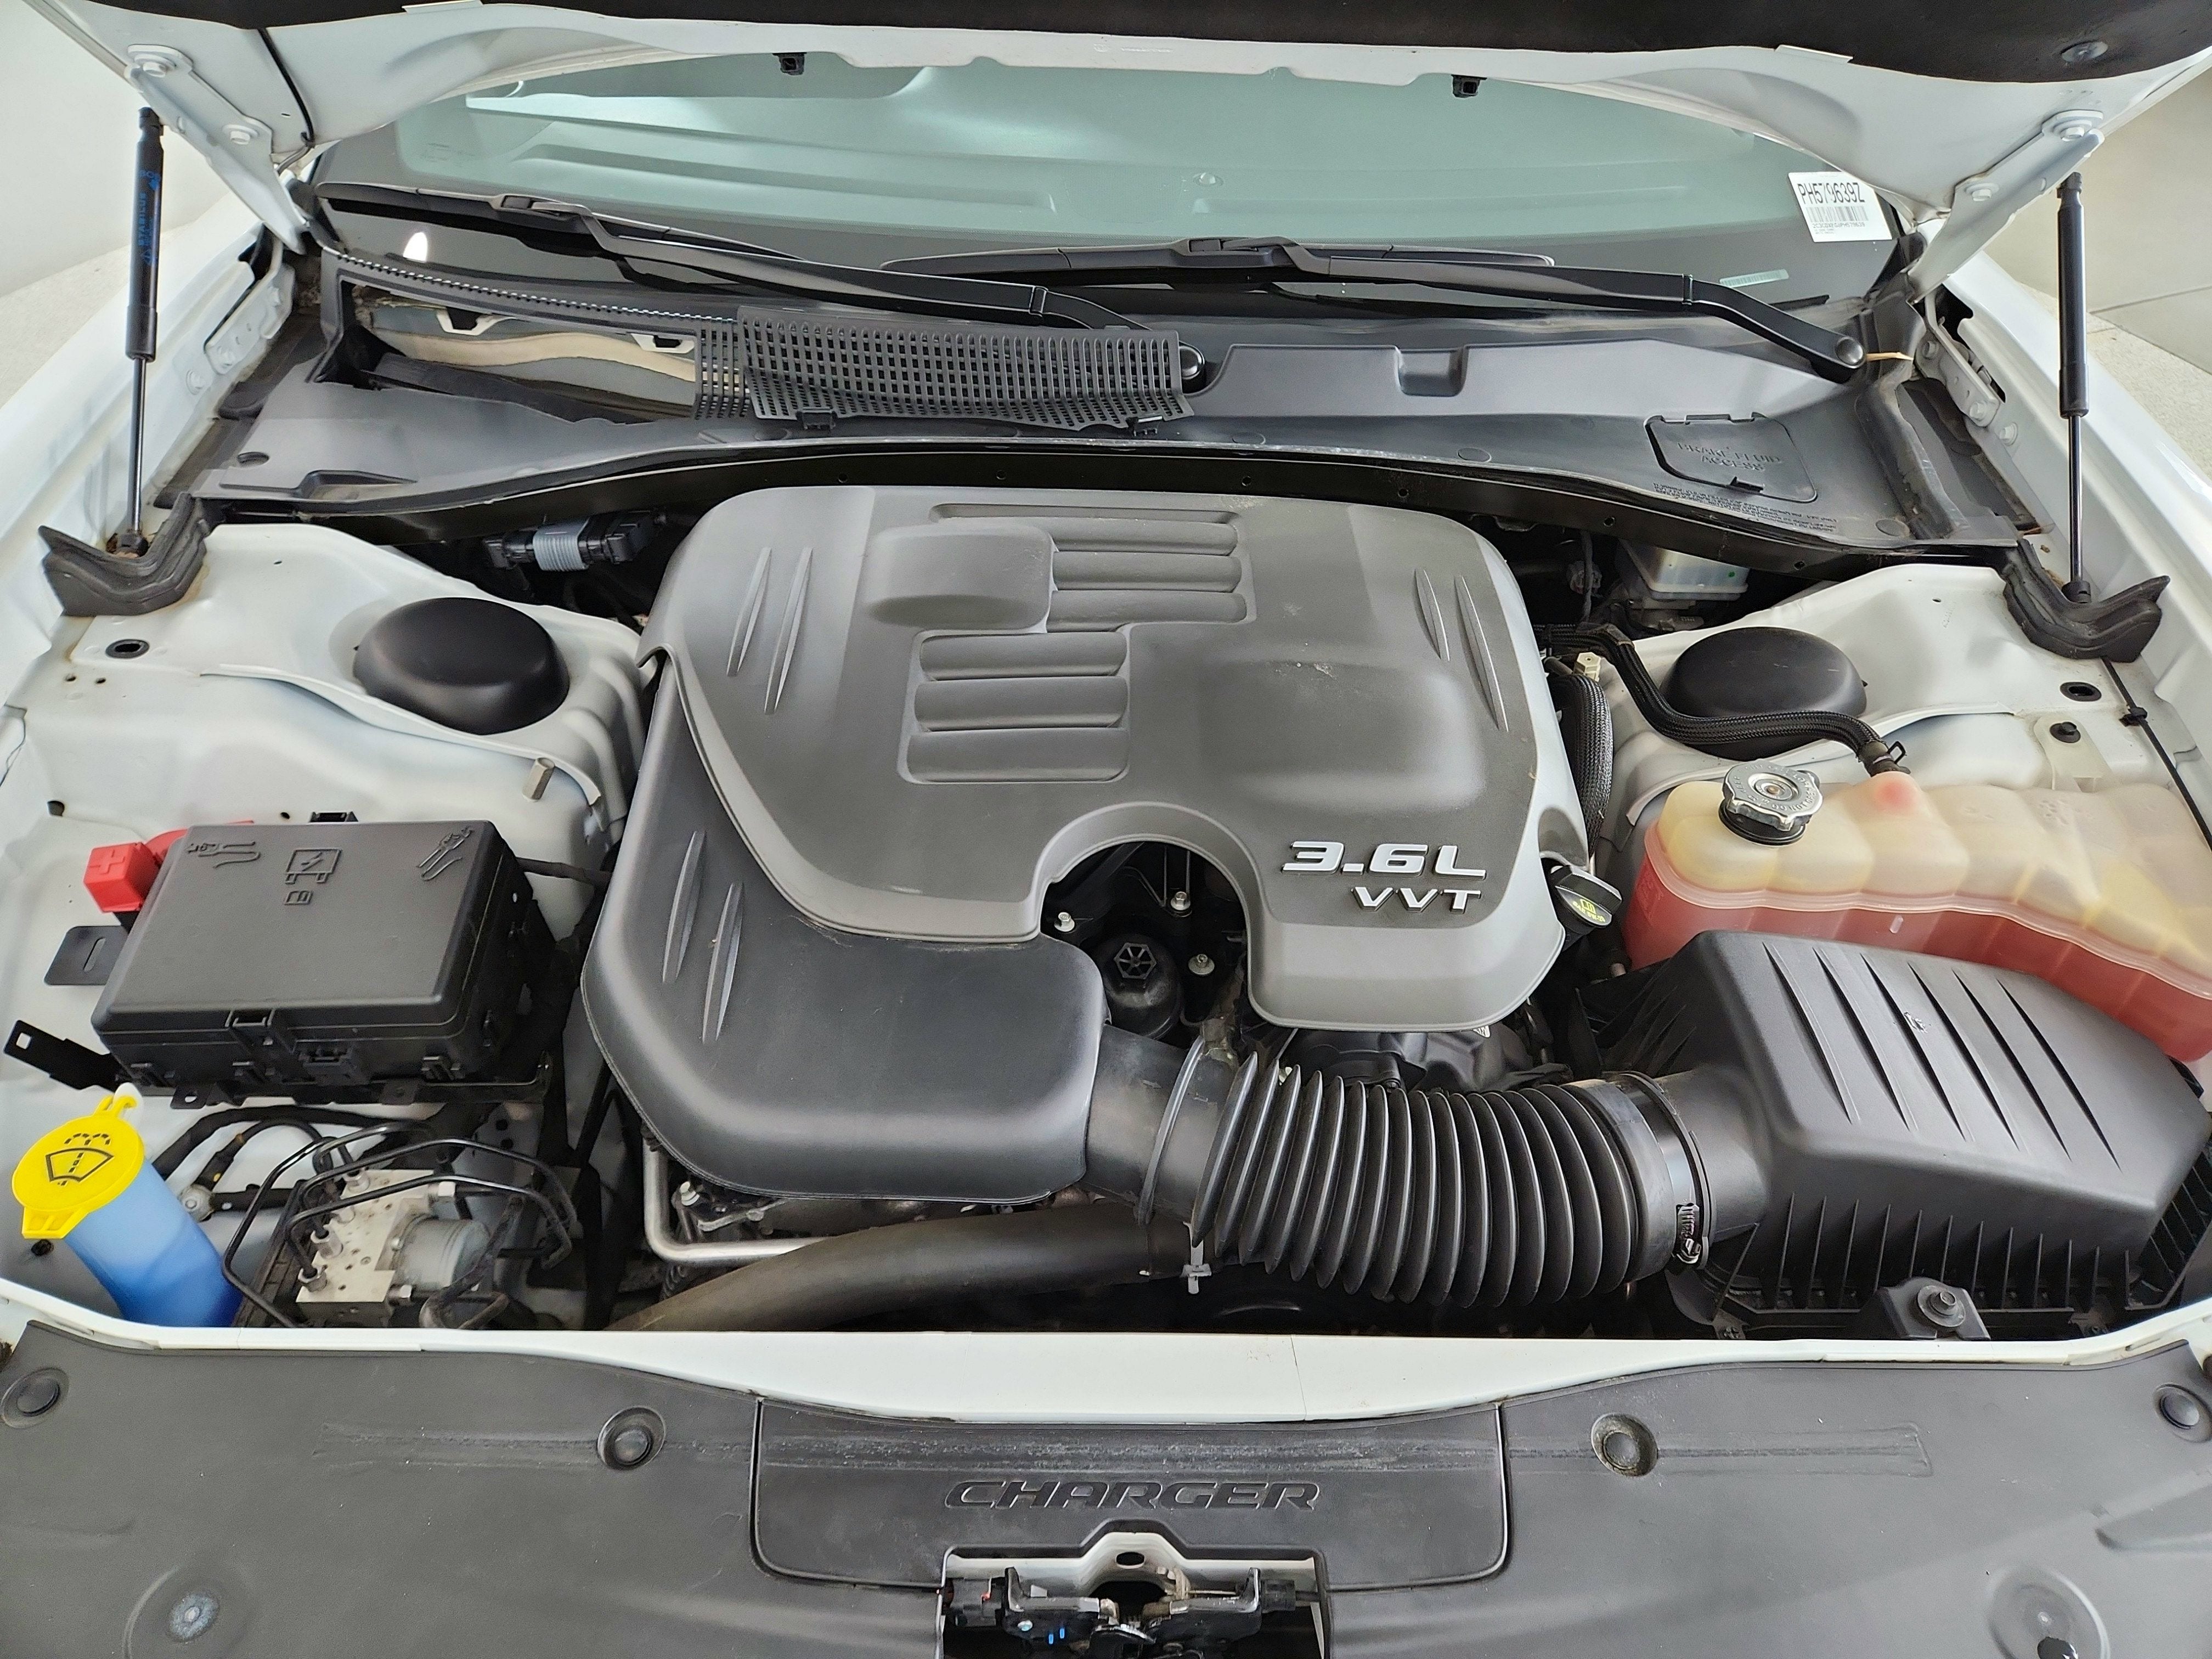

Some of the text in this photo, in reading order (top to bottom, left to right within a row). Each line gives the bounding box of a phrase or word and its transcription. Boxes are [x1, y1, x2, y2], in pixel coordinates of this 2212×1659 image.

[1797, 182, 1865, 205] PH579639Z
[1282, 840, 1487, 881] 3.6L
[1351, 885, 1482, 915] VVT
[944, 1480, 1320, 1510] CHARGER
